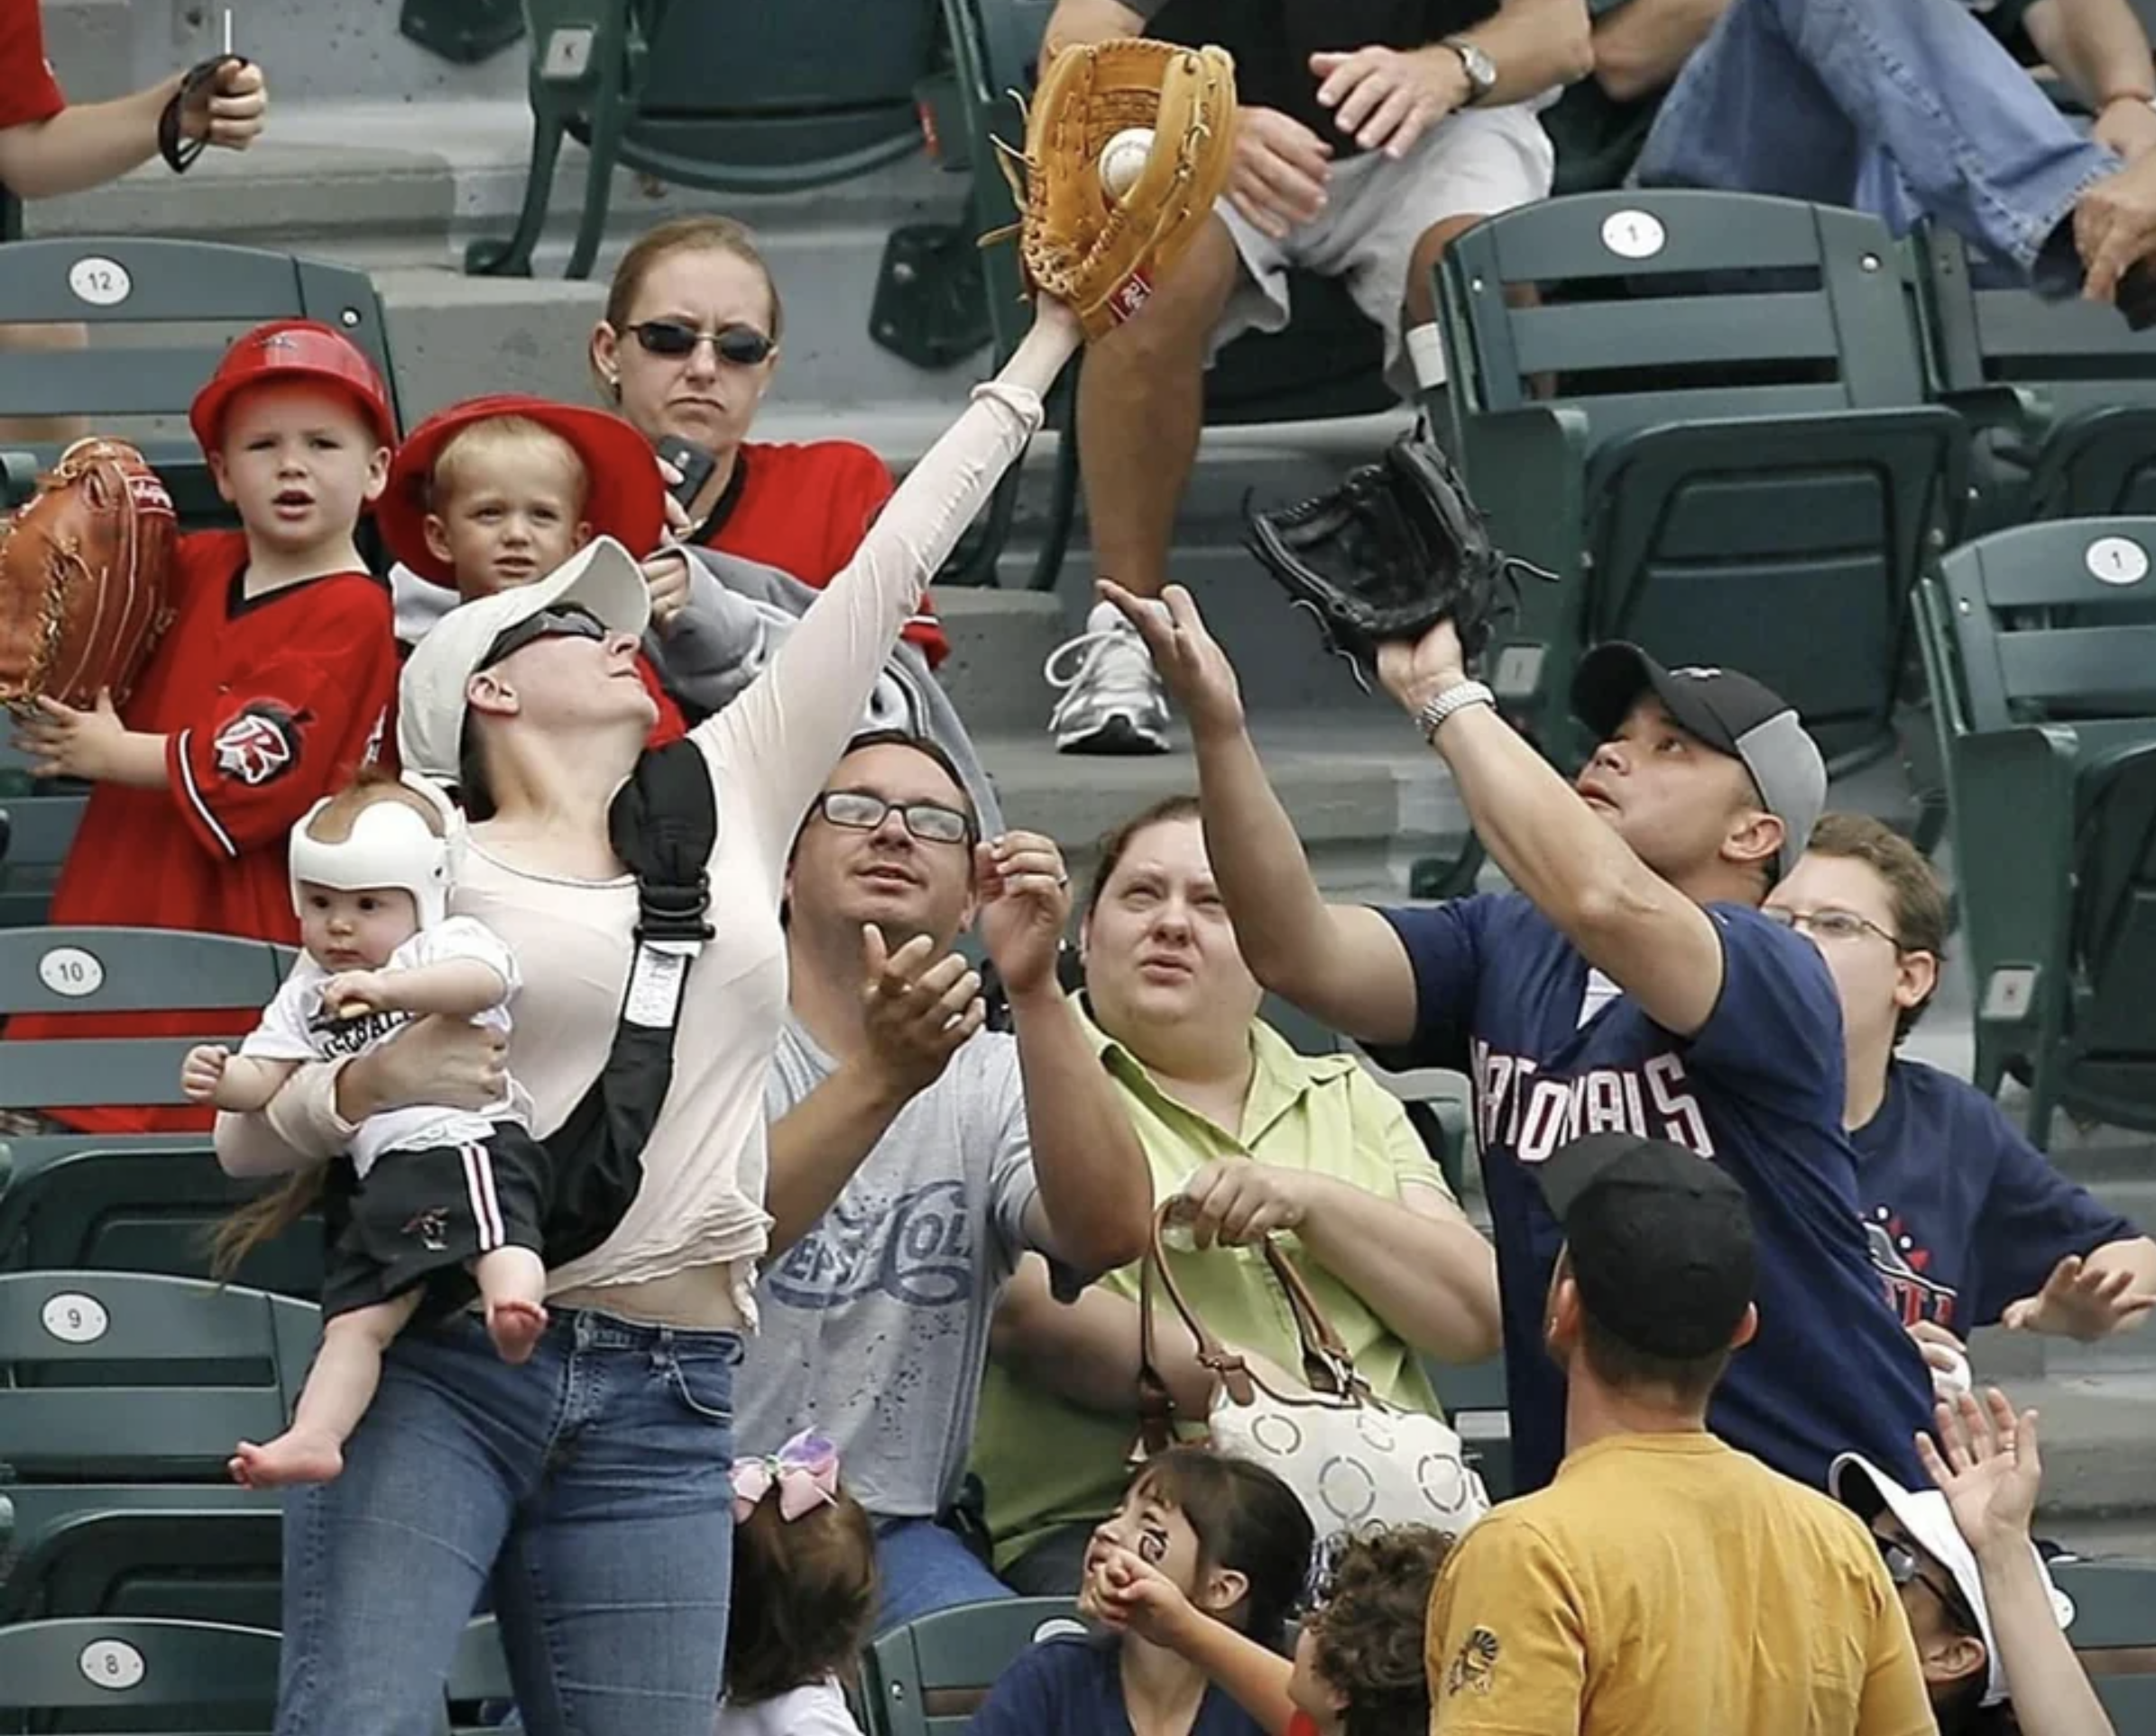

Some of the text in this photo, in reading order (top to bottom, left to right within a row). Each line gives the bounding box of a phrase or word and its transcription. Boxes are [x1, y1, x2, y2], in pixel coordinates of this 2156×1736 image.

[88, 271, 113, 291] 12
[59, 962, 84, 982] 10
[68, 1307, 81, 1329] 9
[106, 1653, 119, 1675] 8
